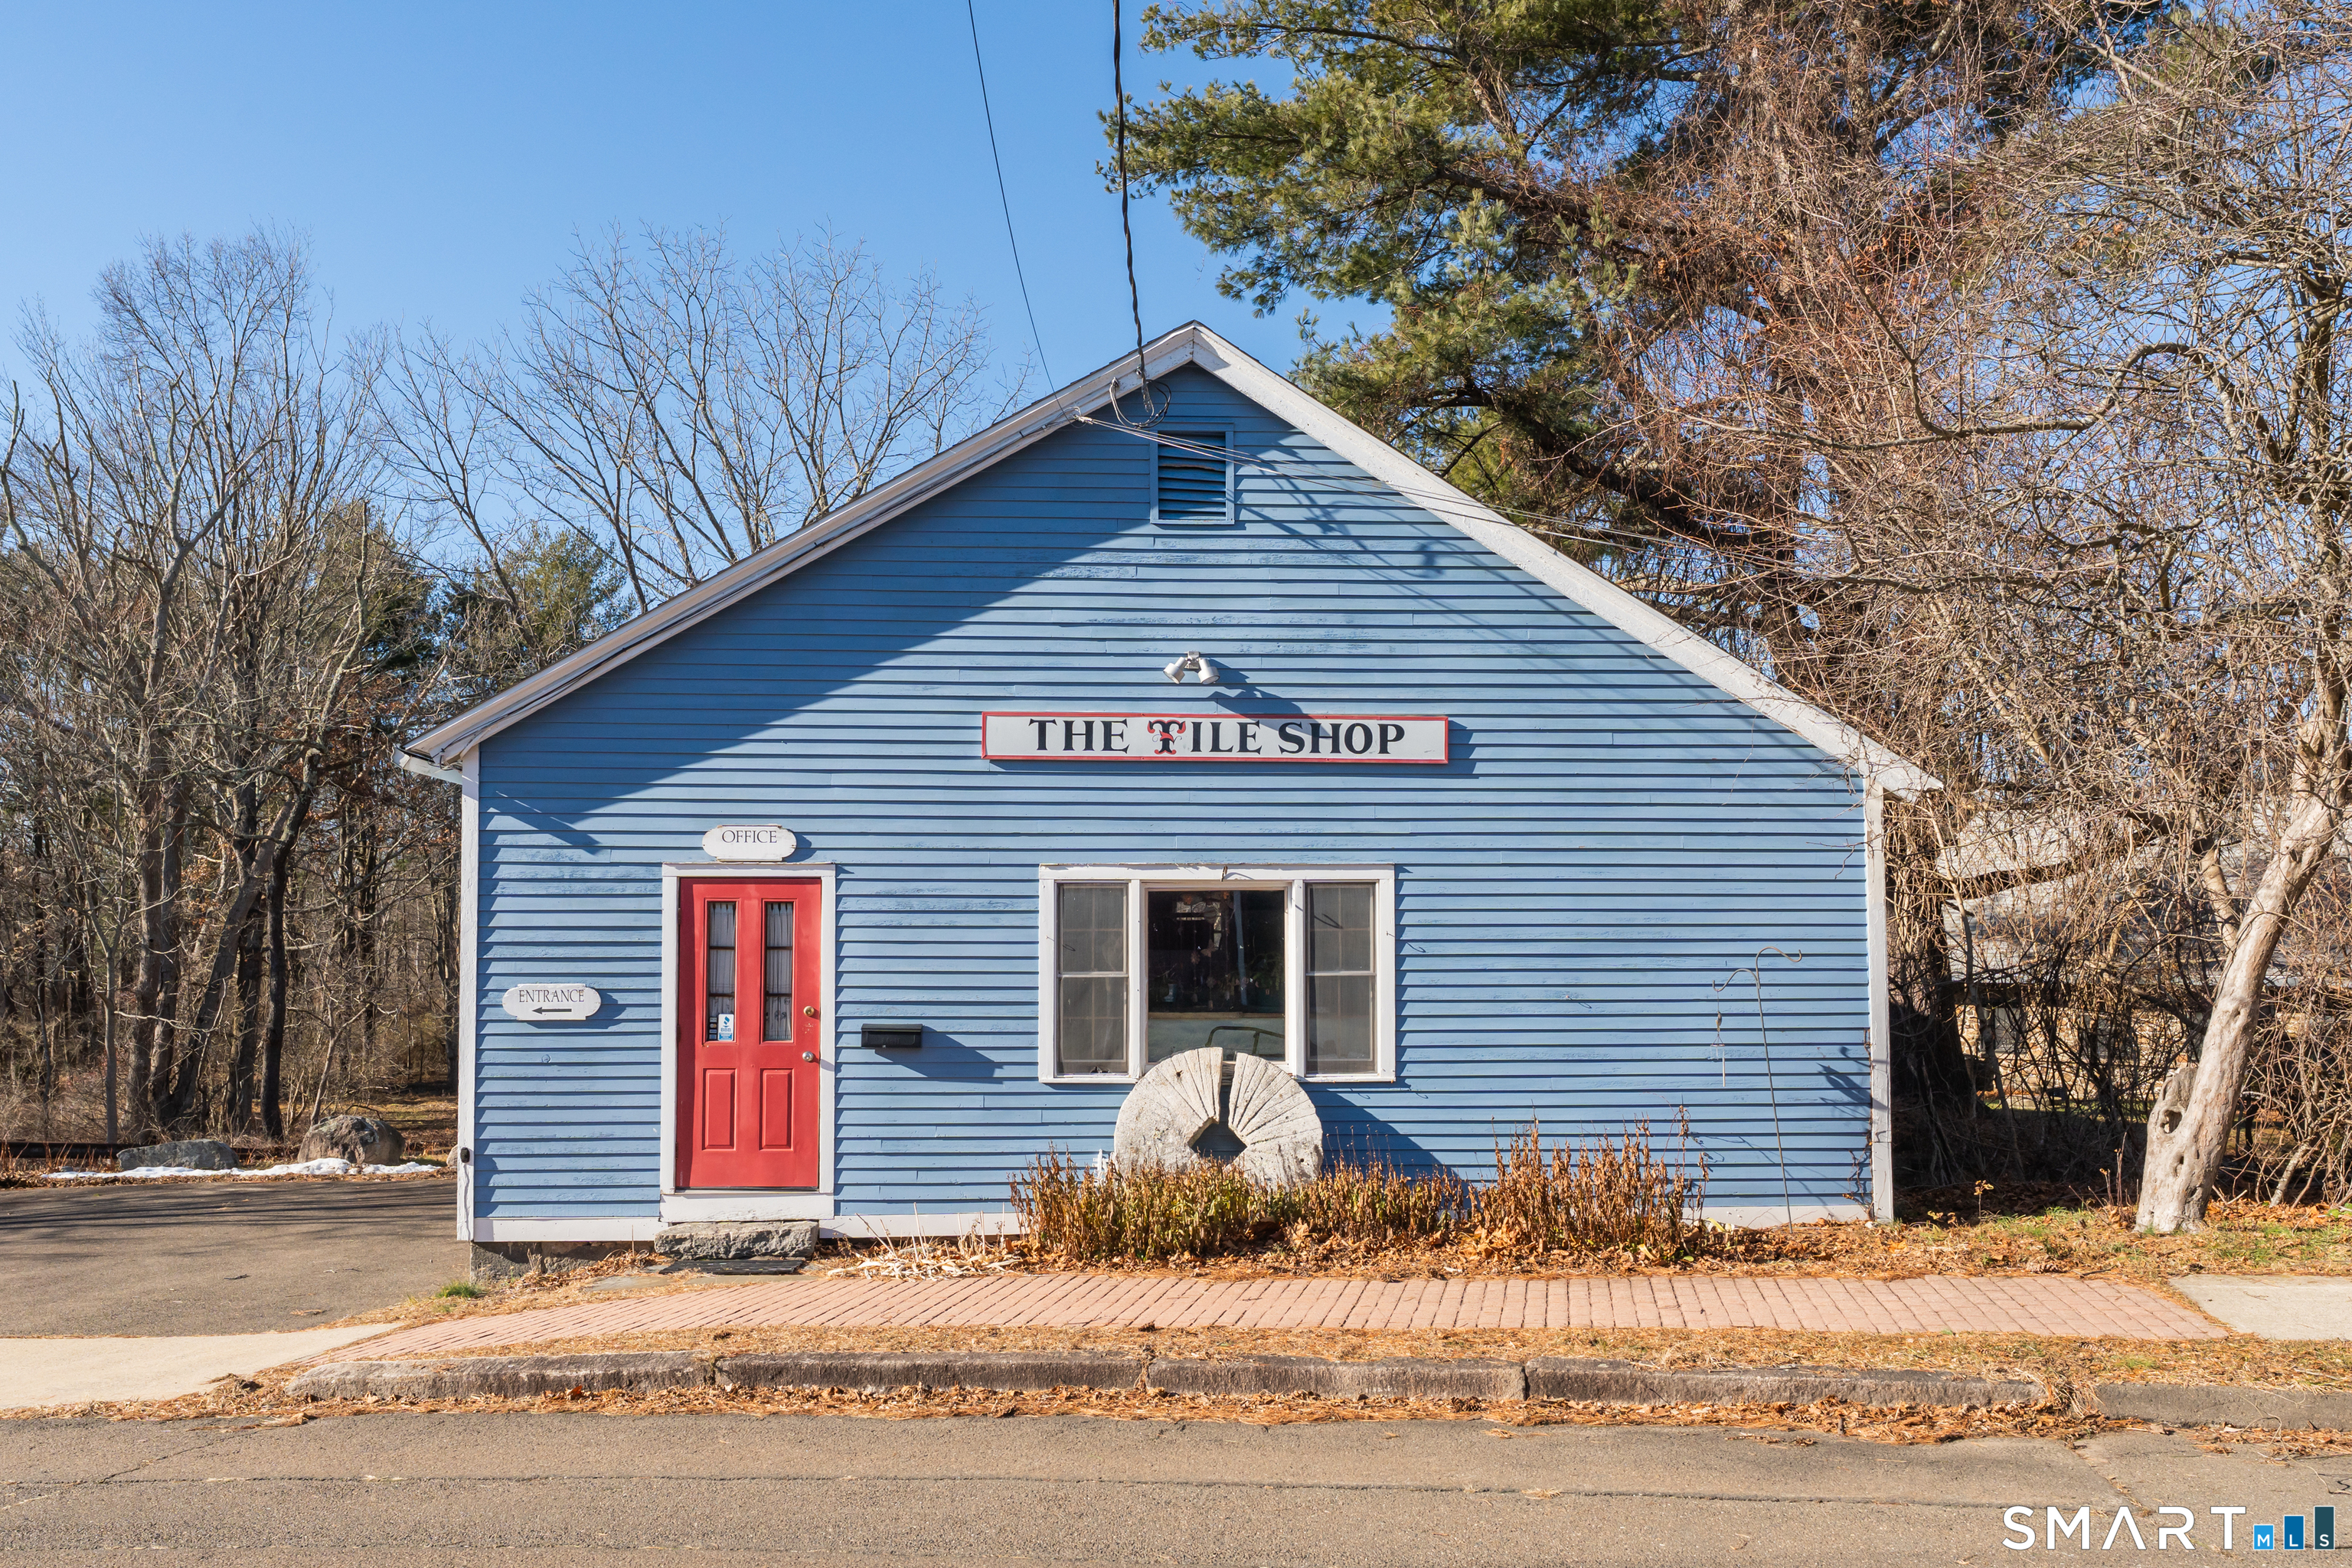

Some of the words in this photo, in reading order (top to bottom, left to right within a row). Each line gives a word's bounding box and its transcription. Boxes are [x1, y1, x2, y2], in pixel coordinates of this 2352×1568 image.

[1027, 718, 1130, 754] THE
[1147, 719, 1263, 756] TILE
[1278, 721, 1406, 755] SHOP
[721, 829, 777, 844] OFFICE
[518, 988, 585, 1003] ENTRANCE
